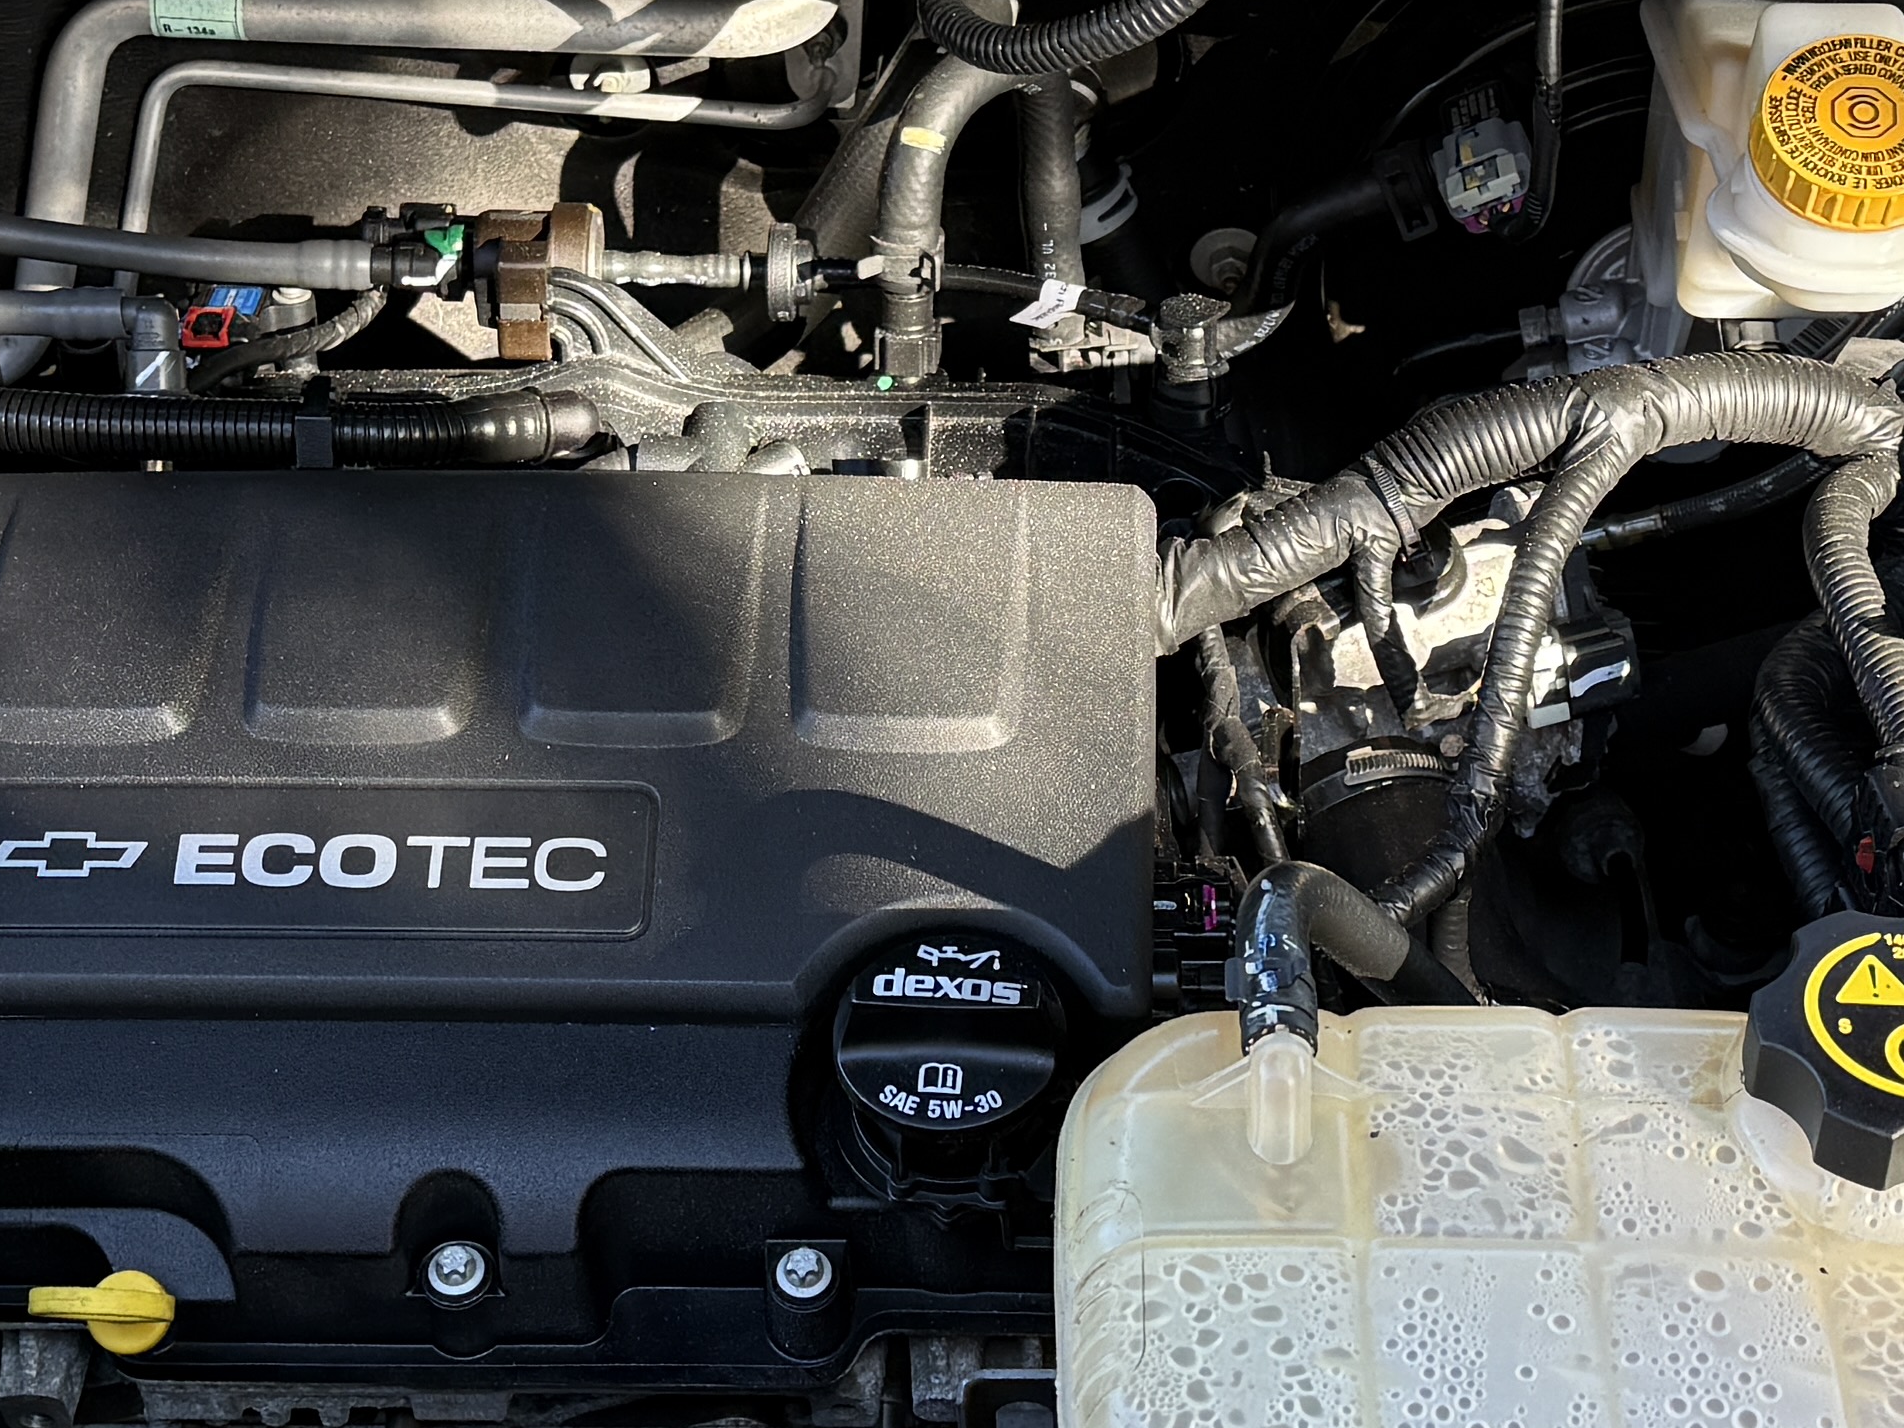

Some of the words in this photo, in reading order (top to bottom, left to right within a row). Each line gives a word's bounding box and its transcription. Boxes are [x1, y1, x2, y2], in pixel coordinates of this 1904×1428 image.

[174, 833, 608, 892] ECOTEC
[872, 967, 1023, 1005] dexos
[878, 1084, 921, 1116] SAE
[927, 1089, 1003, 1119] 5W-30
